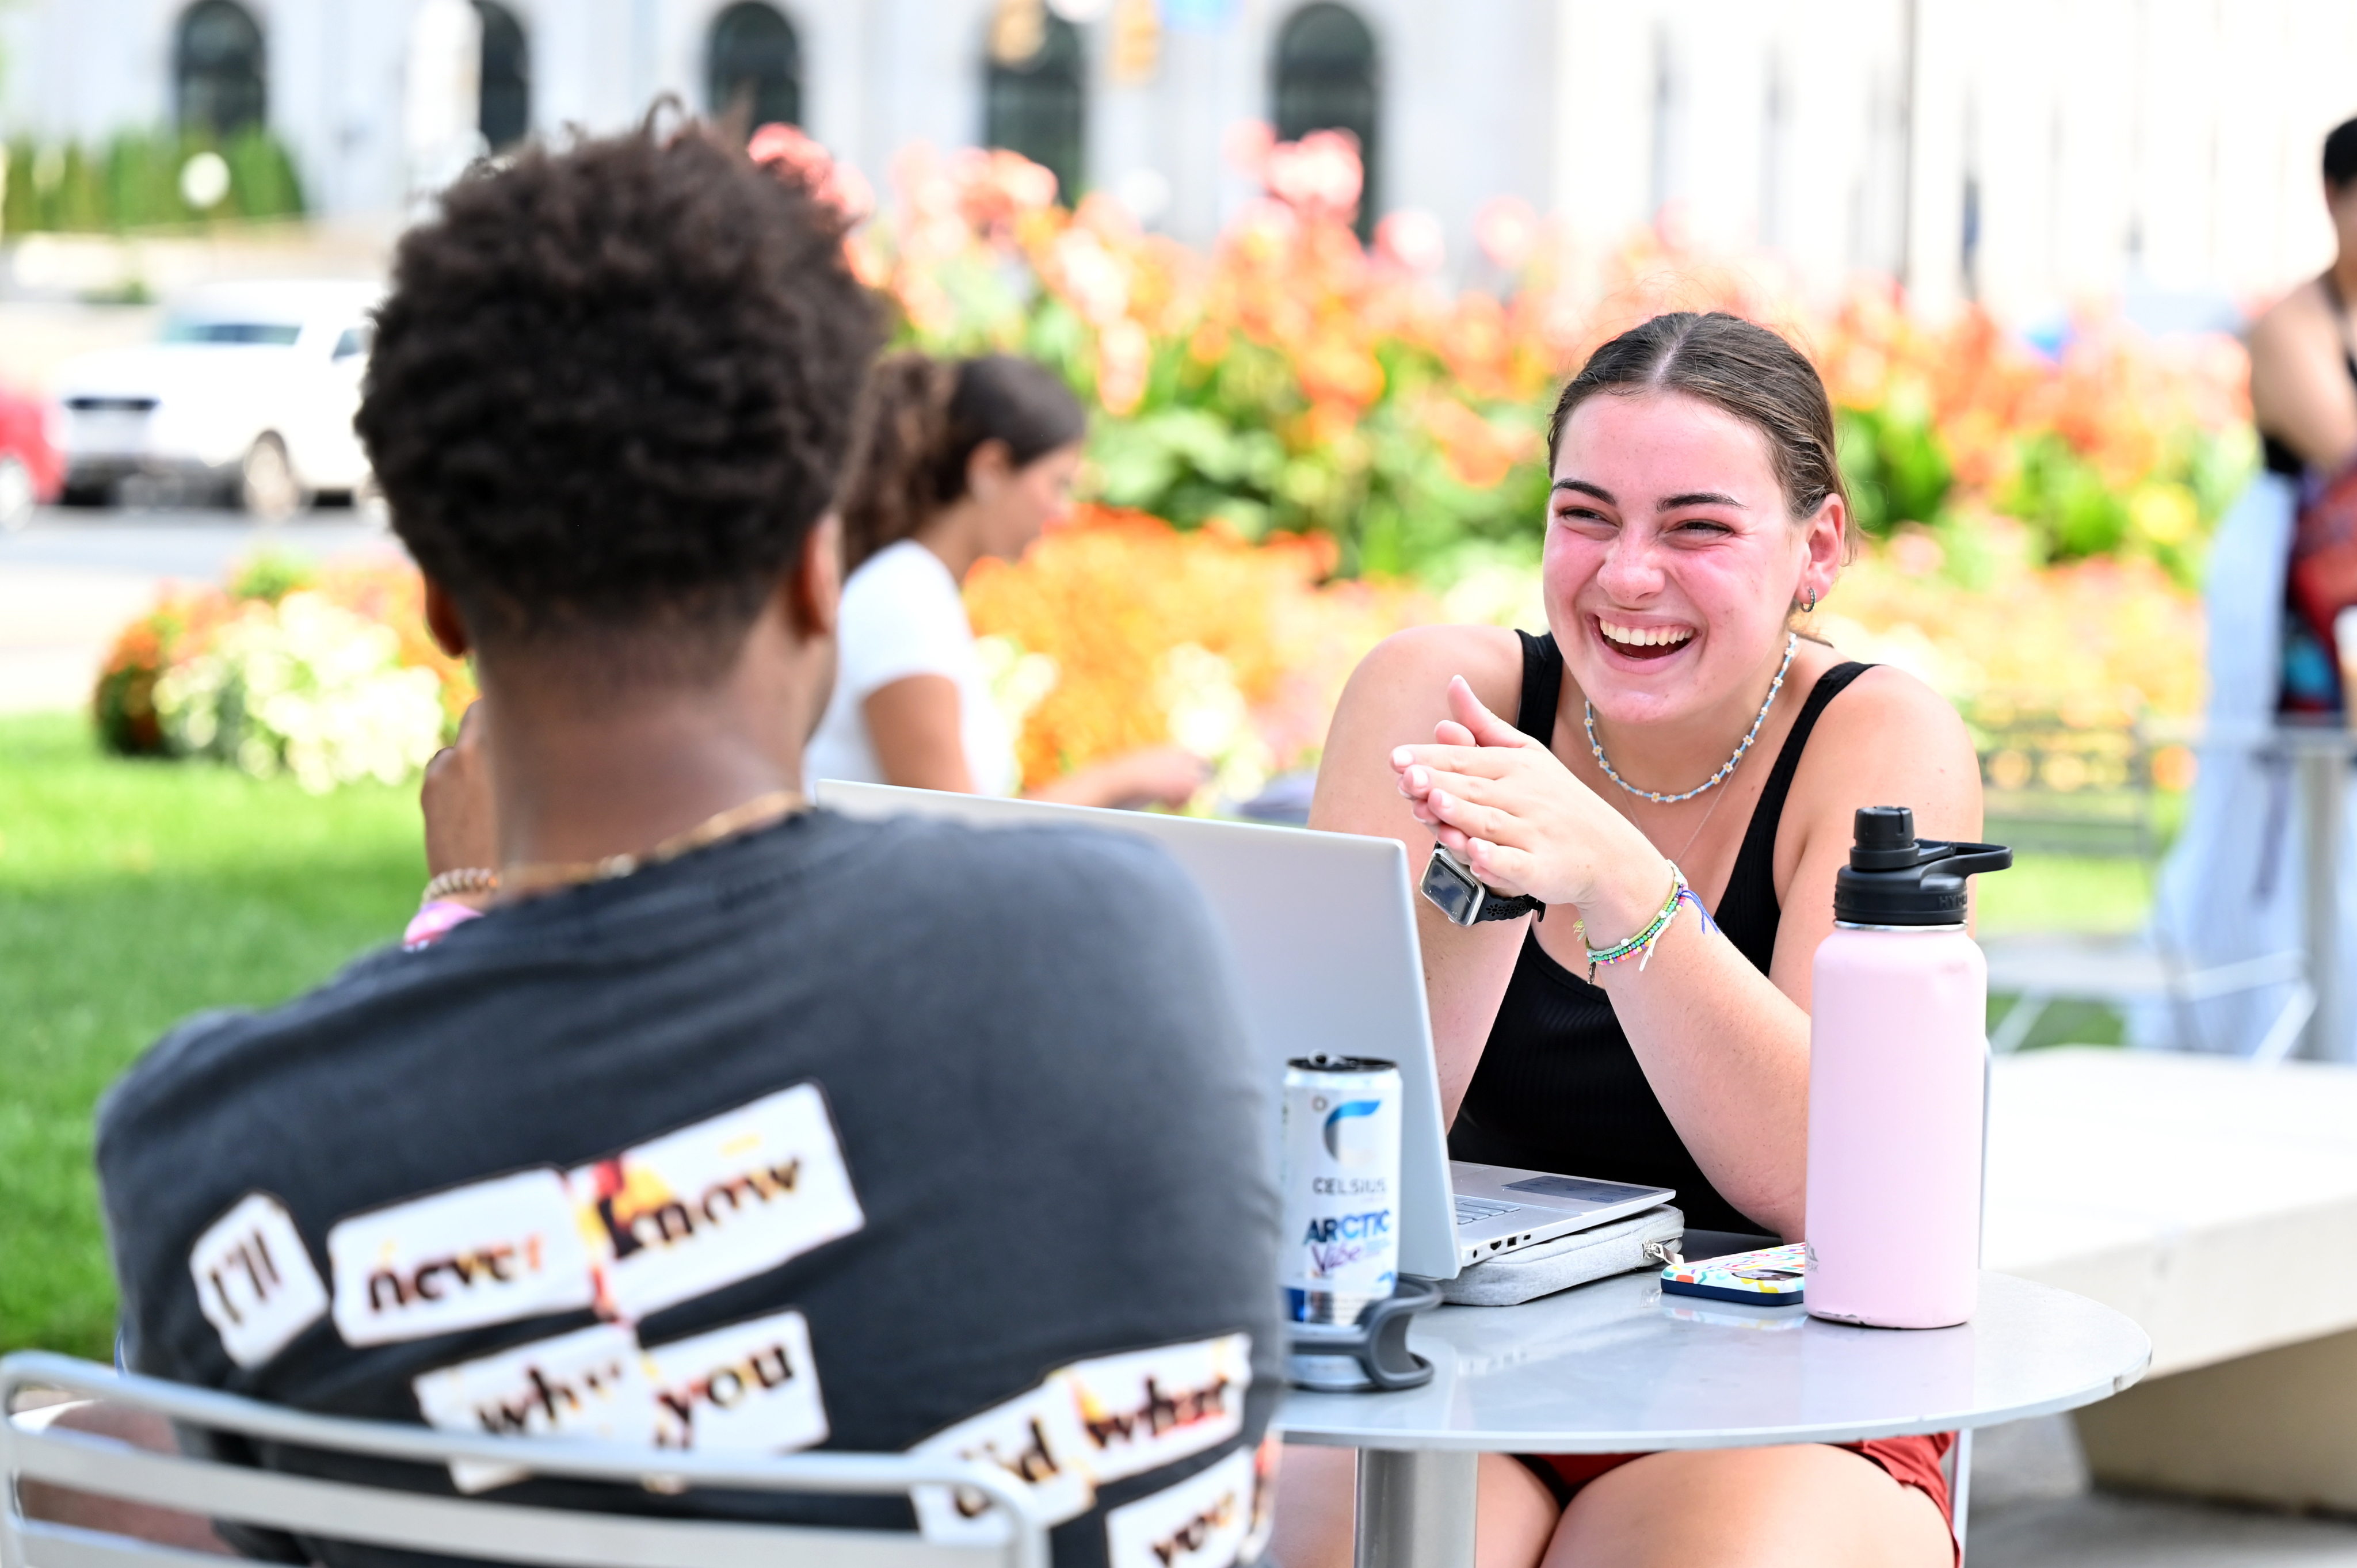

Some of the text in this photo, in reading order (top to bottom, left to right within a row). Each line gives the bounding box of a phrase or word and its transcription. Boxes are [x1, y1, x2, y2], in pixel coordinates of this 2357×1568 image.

[1313, 1177, 1386, 1196] CELSIUS
[210, 1155, 798, 1325] I'll never know
[1303, 1209, 1390, 1246] ARCTIC
[1310, 1241, 1361, 1273] Vibe
[653, 1345, 794, 1450] you
[1085, 1374, 1229, 1449] what
